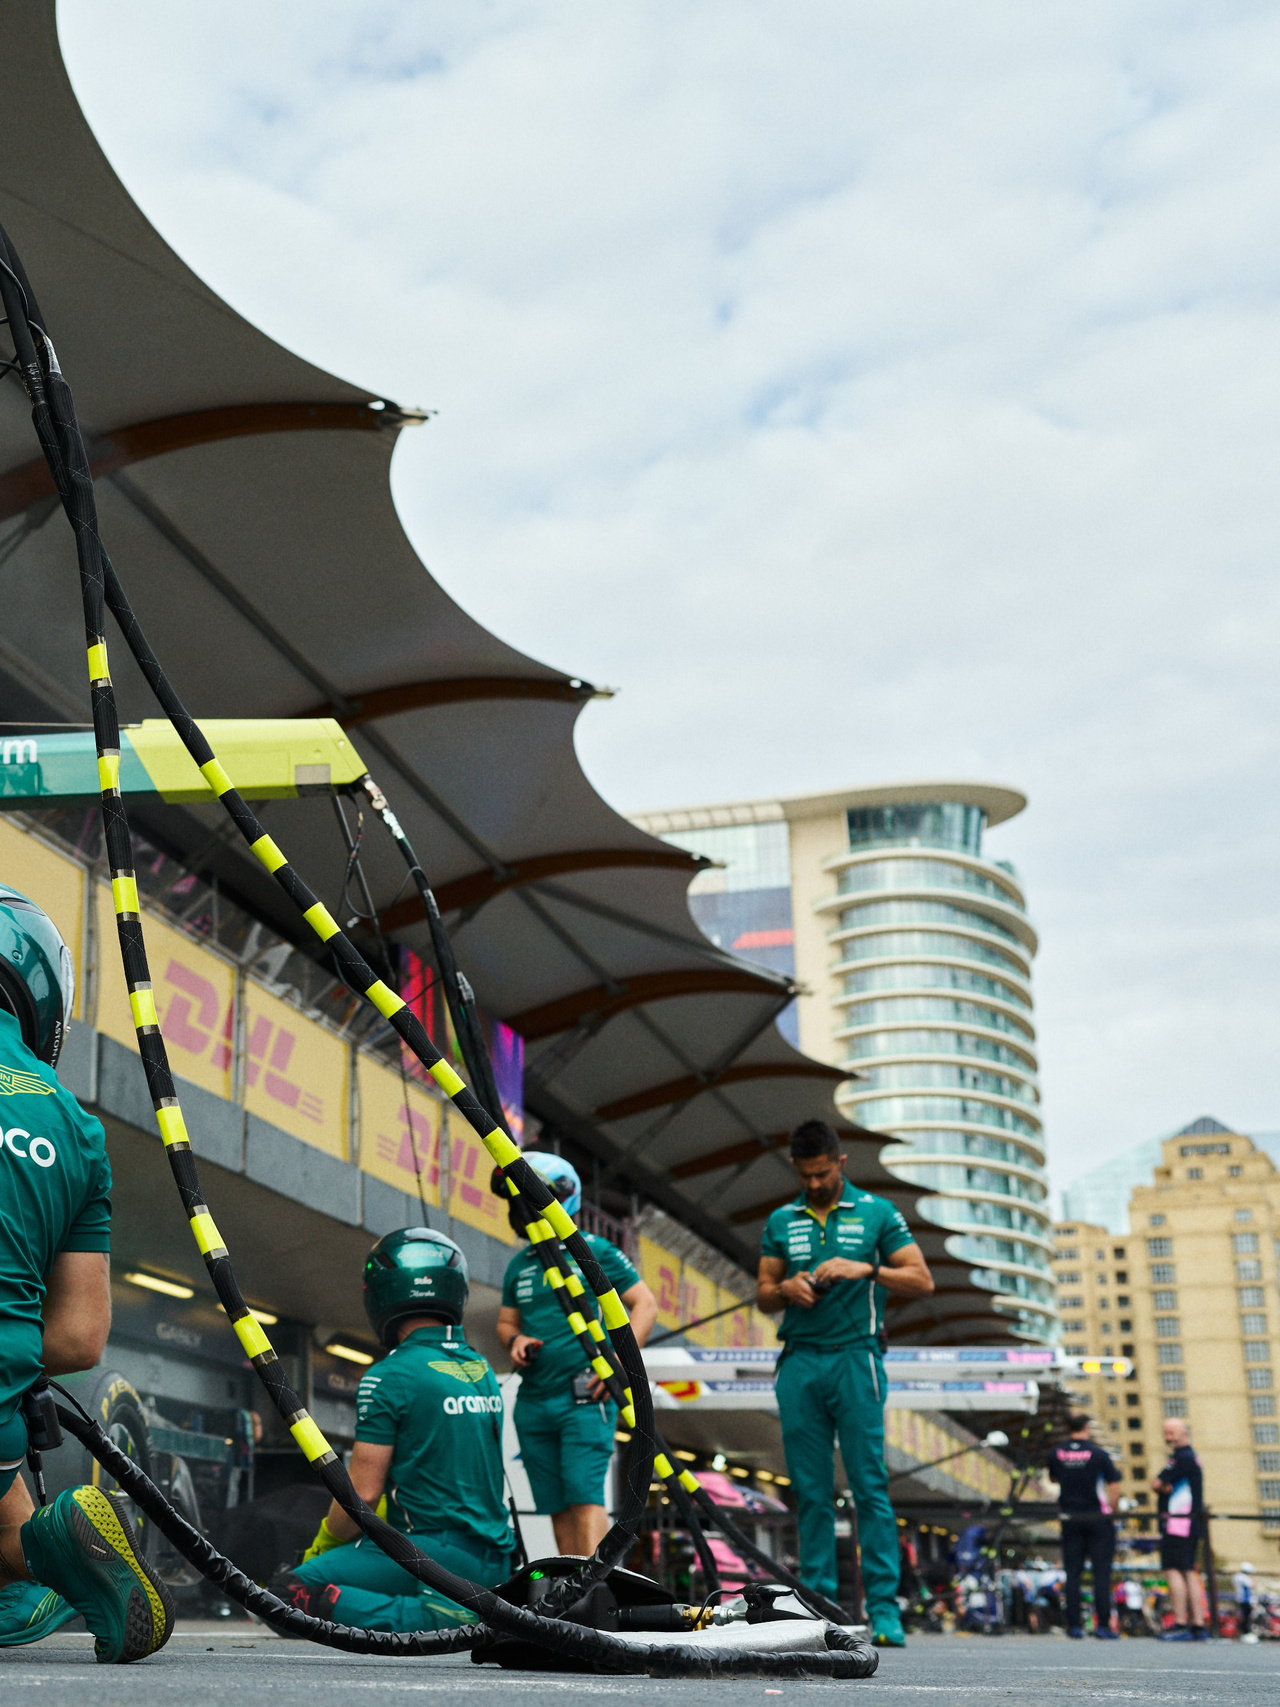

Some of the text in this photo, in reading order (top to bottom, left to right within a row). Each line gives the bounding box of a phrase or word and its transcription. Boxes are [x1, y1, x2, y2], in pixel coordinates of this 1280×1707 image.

[51, 1020, 61, 1055] ASTON
[161, 957, 302, 1110] DHL
[396, 1102, 484, 1208] DHL
